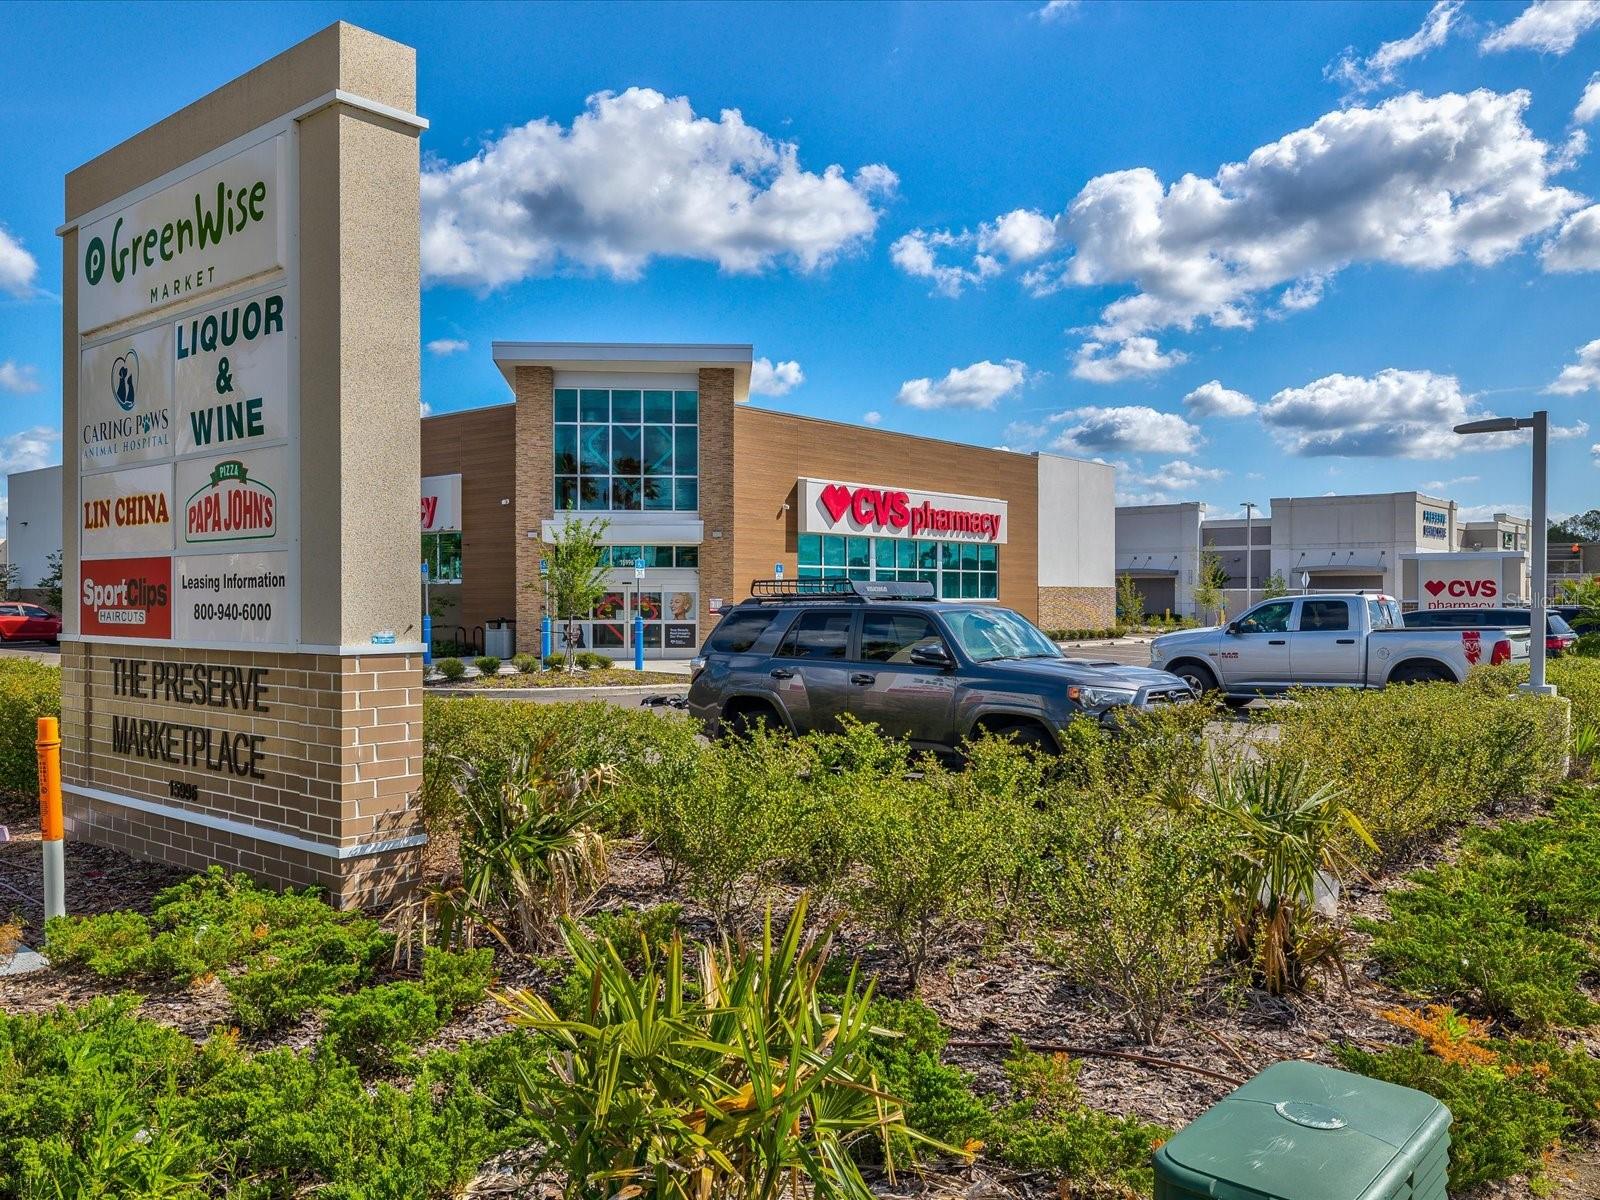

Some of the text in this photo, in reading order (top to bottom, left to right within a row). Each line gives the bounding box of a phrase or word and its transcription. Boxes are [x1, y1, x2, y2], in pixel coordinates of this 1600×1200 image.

[111, 181, 266, 283] GreenWise
[150, 266, 215, 304] MARKET
[177, 295, 284, 360] LIQUOR
[215, 356, 234, 395] &
[83, 417, 132, 445] CARING
[190, 397, 265, 446] WINE
[83, 434, 169, 459] ANIMAL HOSPITAL
[219, 463, 239, 478] PIZZA
[84, 492, 169, 530] LIN CHINA
[188, 489, 273, 534] PAPA JOHN'S
[851, 487, 1001, 540] CVS pharmacy
[182, 572, 285, 592] Leasing Information
[1447, 579, 1497, 598] CVS
[100, 611, 145, 623] HAIRCUTS
[194, 603, 272, 621] 800-940-6000
[110, 658, 270, 713] THE PRESERVE
[112, 715, 266, 780] MARKETPLACE
